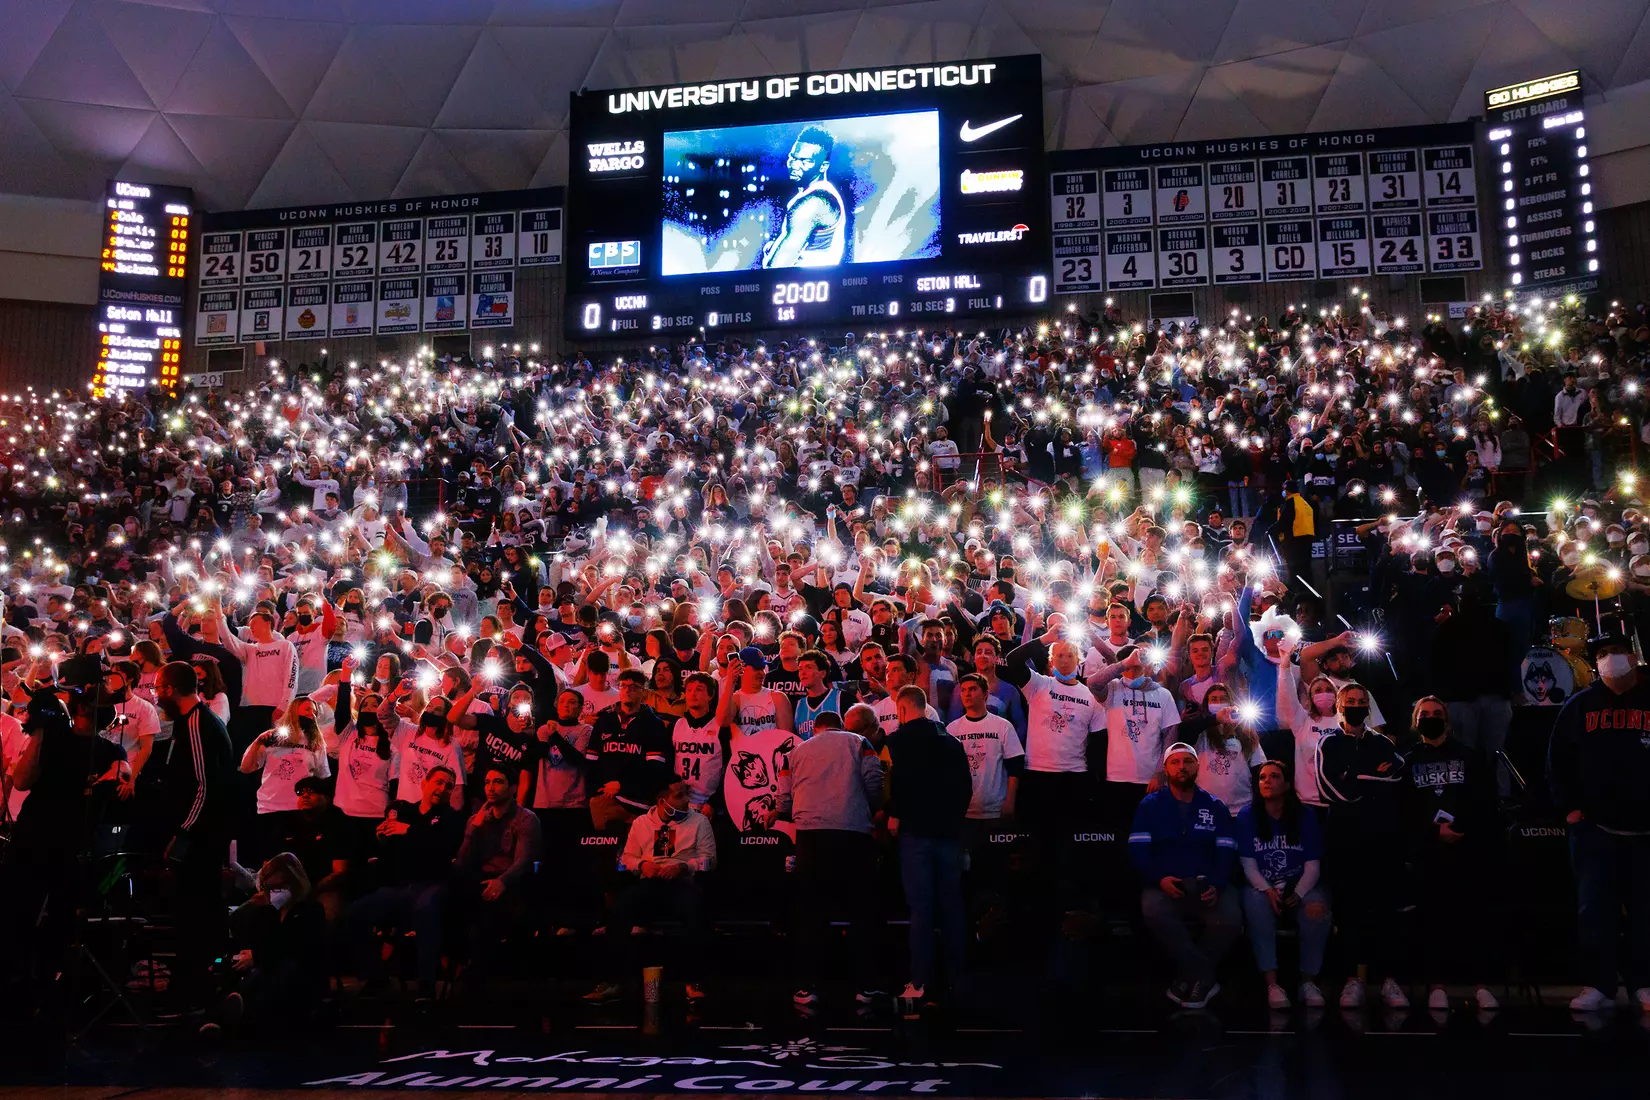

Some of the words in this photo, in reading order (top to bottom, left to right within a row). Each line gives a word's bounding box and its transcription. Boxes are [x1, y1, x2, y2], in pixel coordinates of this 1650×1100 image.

[608, 80, 759, 114] UNIVERSITY
[766, 77, 800, 100] OF
[807, 64, 996, 96] CONNECTICUT
[1512, 75, 1578, 100] HUSKIES
[1502, 107, 1526, 122] STAT
[1530, 98, 1567, 116] BOARD
[588, 140, 645, 156] WELLS
[1141, 146, 1196, 158] UCONN
[1206, 140, 1278, 154] HUSKIES
[1290, 138, 1308, 148] OF
[1319, 134, 1376, 146] HONOR
[589, 156, 644, 172] FARGO
[1211, 172, 1255, 184] MONTGOMERY
[1437, 172, 1461, 195] 14
[1525, 178, 1530, 186] 3
[1533, 175, 1543, 184] PT
[1546, 172, 1557, 182] FG
[116, 182, 150, 197] UConn
[1277, 182, 1296, 205] 31
[1329, 178, 1350, 202] 23
[1382, 174, 1405, 199] 31
[1123, 193, 1133, 215] 3
[1223, 186, 1244, 208] 20
[1520, 190, 1566, 206] REBOUNDS
[280, 209, 327, 220] UCONN
[335, 204, 396, 216] HUSKIES
[406, 203, 422, 211] OF
[431, 198, 479, 209] HONOR
[1066, 197, 1085, 218] 32
[1526, 209, 1562, 223] ASSISTS
[958, 230, 1017, 244] TRAVELERS
[1326, 230, 1360, 240] WILLIAMS
[1521, 226, 1572, 243] TURNOVERS
[436, 239, 458, 261] 25
[485, 236, 502, 257] 33
[533, 233, 548, 254] 10
[590, 242, 635, 259] CBS
[1112, 243, 1148, 253] JEFFERSON
[1167, 239, 1198, 250] STEWART
[1380, 239, 1418, 263] 24
[1437, 236, 1473, 260] 33
[298, 250, 321, 270] 21
[342, 246, 368, 267] 52
[386, 243, 416, 264] 42
[1229, 249, 1244, 272] 3
[1275, 246, 1304, 270] CD
[1332, 243, 1355, 266] 15
[1531, 247, 1564, 260] BLOCKS
[206, 255, 235, 276] 24
[250, 252, 279, 273] 50
[1062, 258, 1092, 282] 23
[1123, 256, 1137, 278] 4
[1168, 252, 1197, 276] 30
[481, 274, 504, 283] NATIONAL
[614, 267, 640, 277] Company
[883, 275, 903, 284] POSS
[1534, 266, 1566, 280] STEALS
[434, 277, 457, 286] NATIONAL
[480, 283, 505, 292] CHAMPION
[735, 284, 760, 293] BONUS
[843, 277, 868, 286] BONUS
[917, 276, 950, 292] SETON
[954, 275, 980, 288] HALL
[1030, 276, 1046, 302] 0
[433, 286, 458, 296] CHAMPION
[701, 286, 720, 295] POSS
[772, 280, 828, 305] 20:00
[852, 305, 865, 316] TM
[868, 304, 884, 314] FLS
[889, 302, 898, 316] 0
[910, 303, 922, 312] 30
[926, 302, 943, 311] SEC
[946, 298, 954, 312] 3
[968, 298, 990, 309] FULL
[107, 306, 141, 321] Seton
[146, 309, 172, 323] Hall
[584, 303, 600, 330] 0
[662, 318, 673, 327] 30
[676, 316, 694, 326] SEC
[709, 312, 718, 326] 0
[719, 314, 733, 324] TM
[736, 312, 752, 322] FLS
[777, 307, 794, 321] 1st
[617, 319, 638, 330] FULL
[653, 316, 661, 329] 3
[200, 375, 222, 385] 201
[1059, 695, 1076, 703] SETON
[1076, 697, 1089, 706] HALL
[880, 714, 891, 722] BEAT
[419, 746, 432, 756] SETON
[431, 751, 444, 761] HALL
[604, 742, 642, 754] UCONN
[675, 742, 715, 754] UCONN
[682, 758, 700, 780] 34
[1413, 771, 1464, 785] HUSKIES
[1074, 833, 1115, 841] UCONN
[1521, 827, 1566, 836] UCONN
[580, 837, 618, 845] UCONN
[740, 837, 779, 845] UCONN
[379, 1050, 782, 1067] Mohegan
[806, 1056, 1002, 1069] Sun
[302, 1071, 662, 1089] Alumni
[674, 1075, 951, 1092] Court
